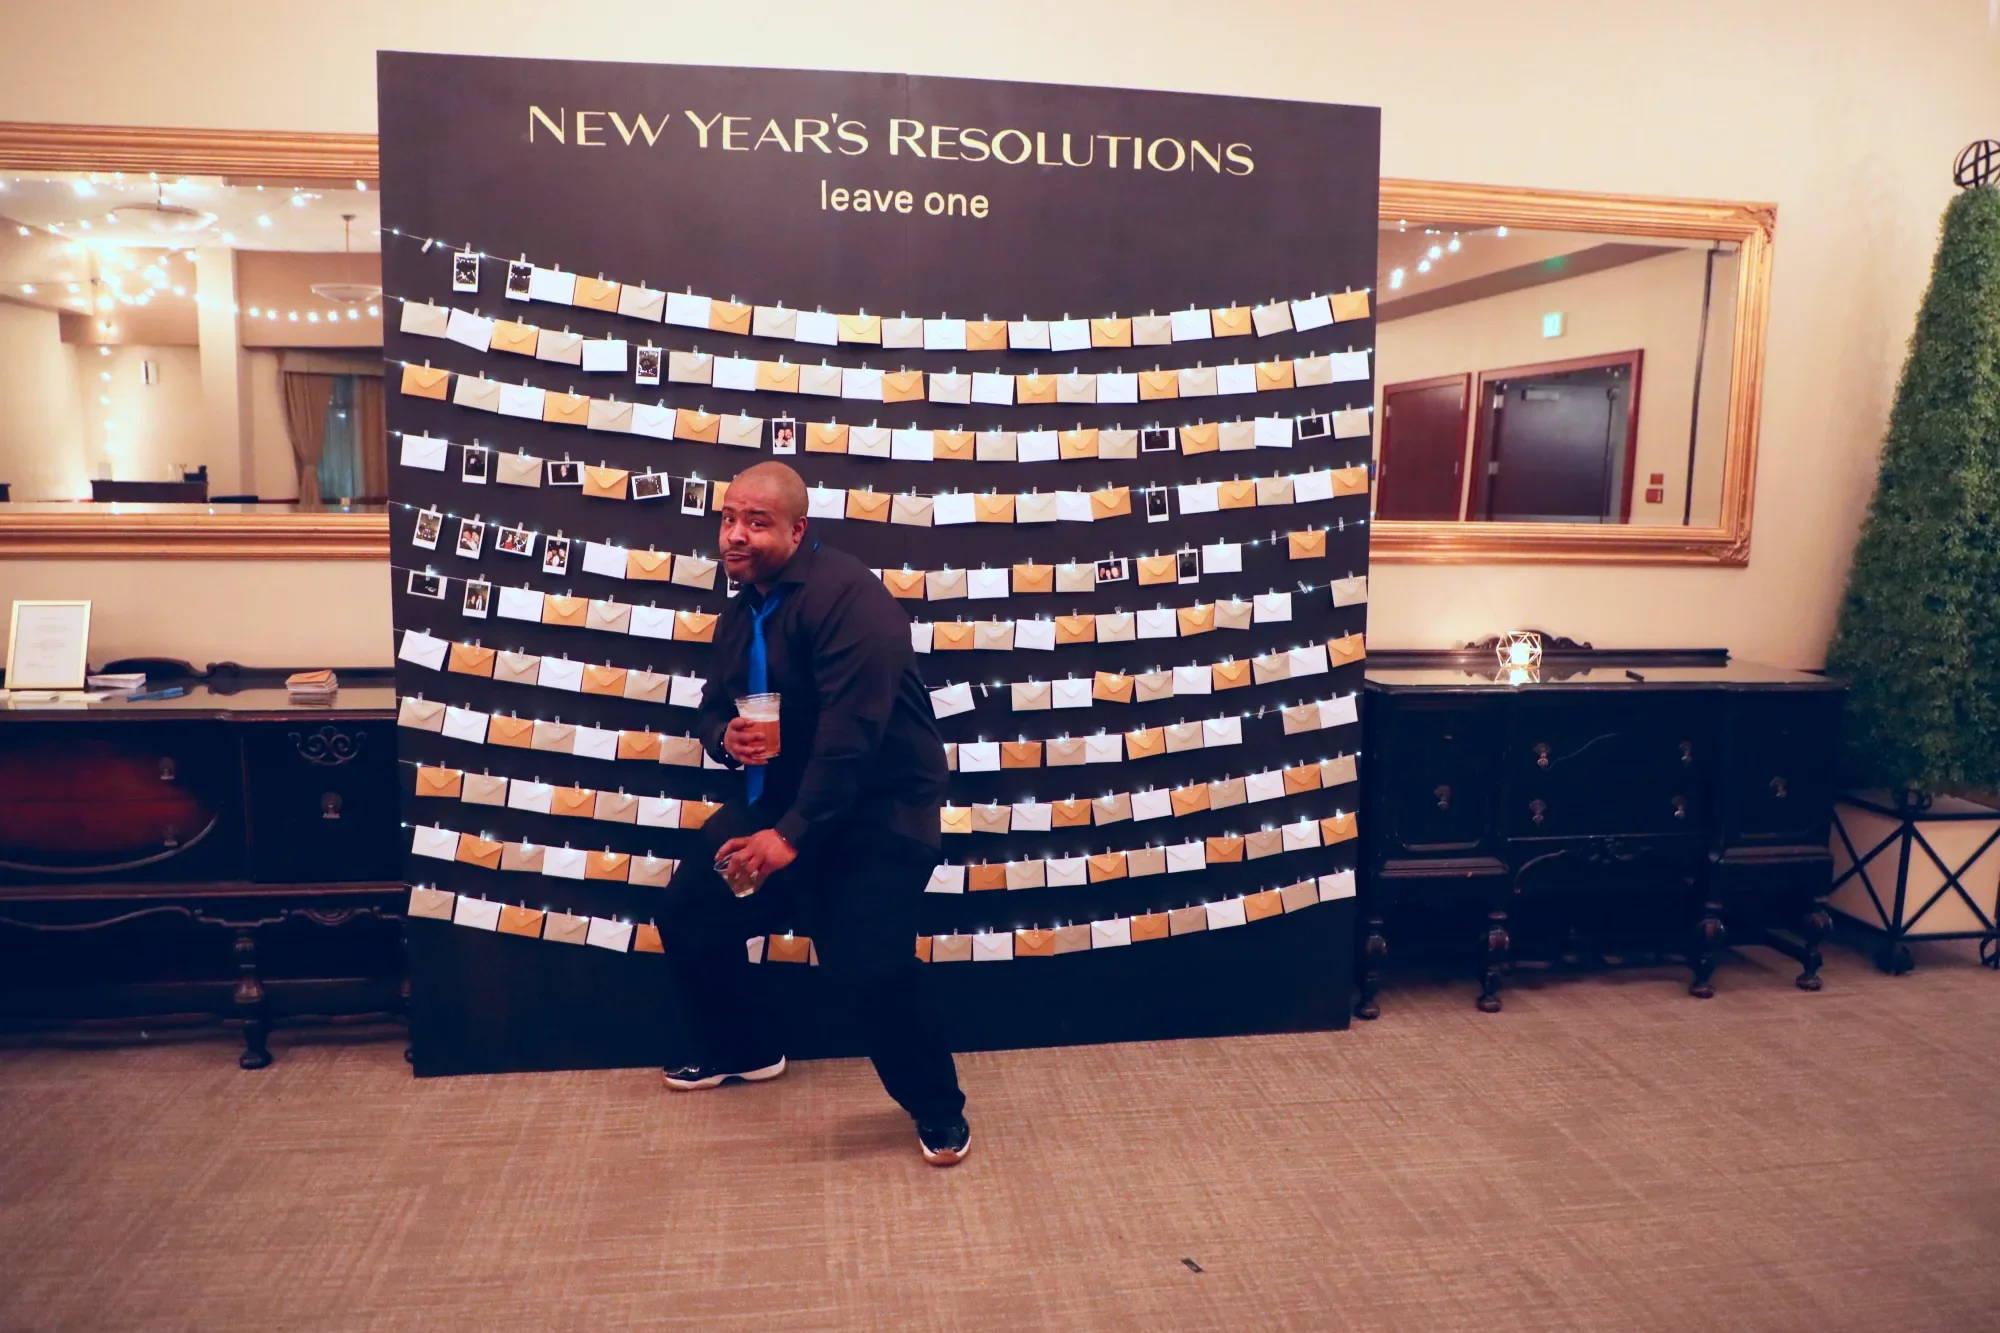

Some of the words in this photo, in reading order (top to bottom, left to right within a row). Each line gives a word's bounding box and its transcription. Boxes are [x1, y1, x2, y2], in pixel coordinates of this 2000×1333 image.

[530, 106, 670, 148] NEW
[684, 110, 869, 159] YEAR'S
[888, 117, 1256, 177] RESOLUTIONS
[819, 178, 915, 215] leave
[923, 191, 989, 220] one
